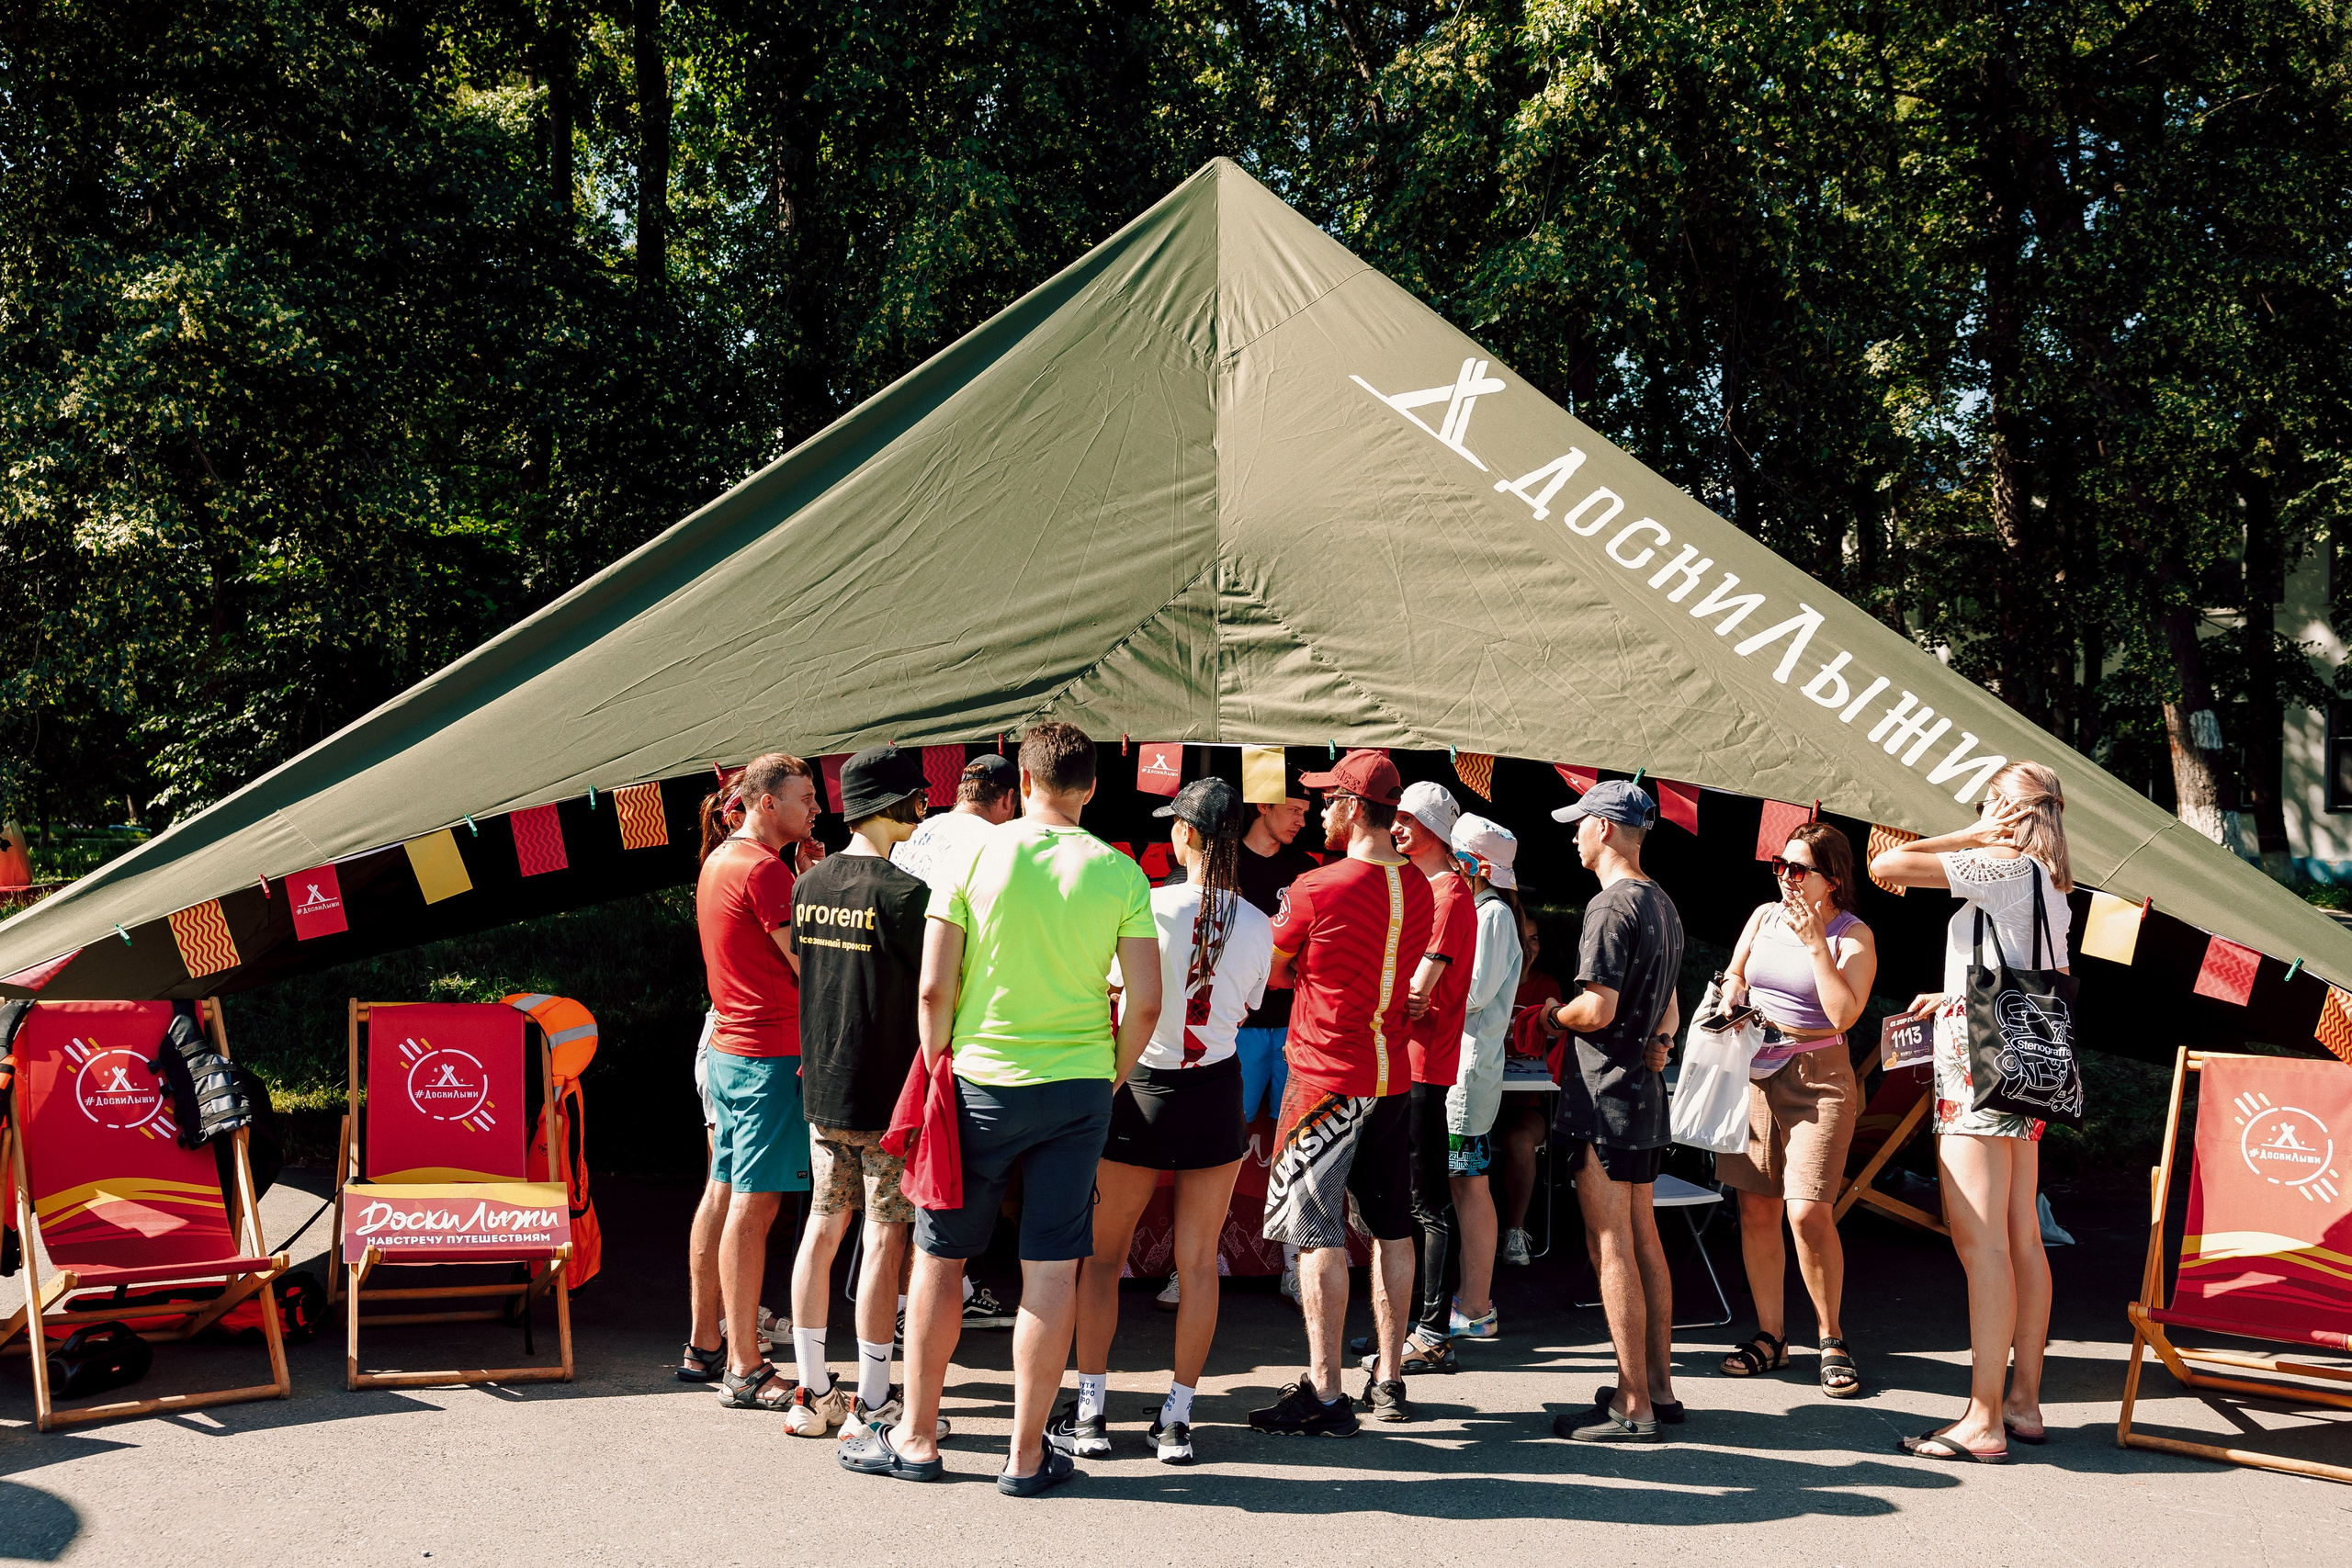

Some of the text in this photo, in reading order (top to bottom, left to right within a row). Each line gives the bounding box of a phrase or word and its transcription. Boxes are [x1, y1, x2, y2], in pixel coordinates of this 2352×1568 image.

[796, 903, 876, 931] prorent
[842, 942, 872, 952] прокат
[1386, 926, 1399, 954] УРАЛУ
[1891, 1025, 1923, 1048] 1113
[367, 1233, 551, 1246] НАВСТРЕЧУ ПУТЕШЕСТВИЯМ
